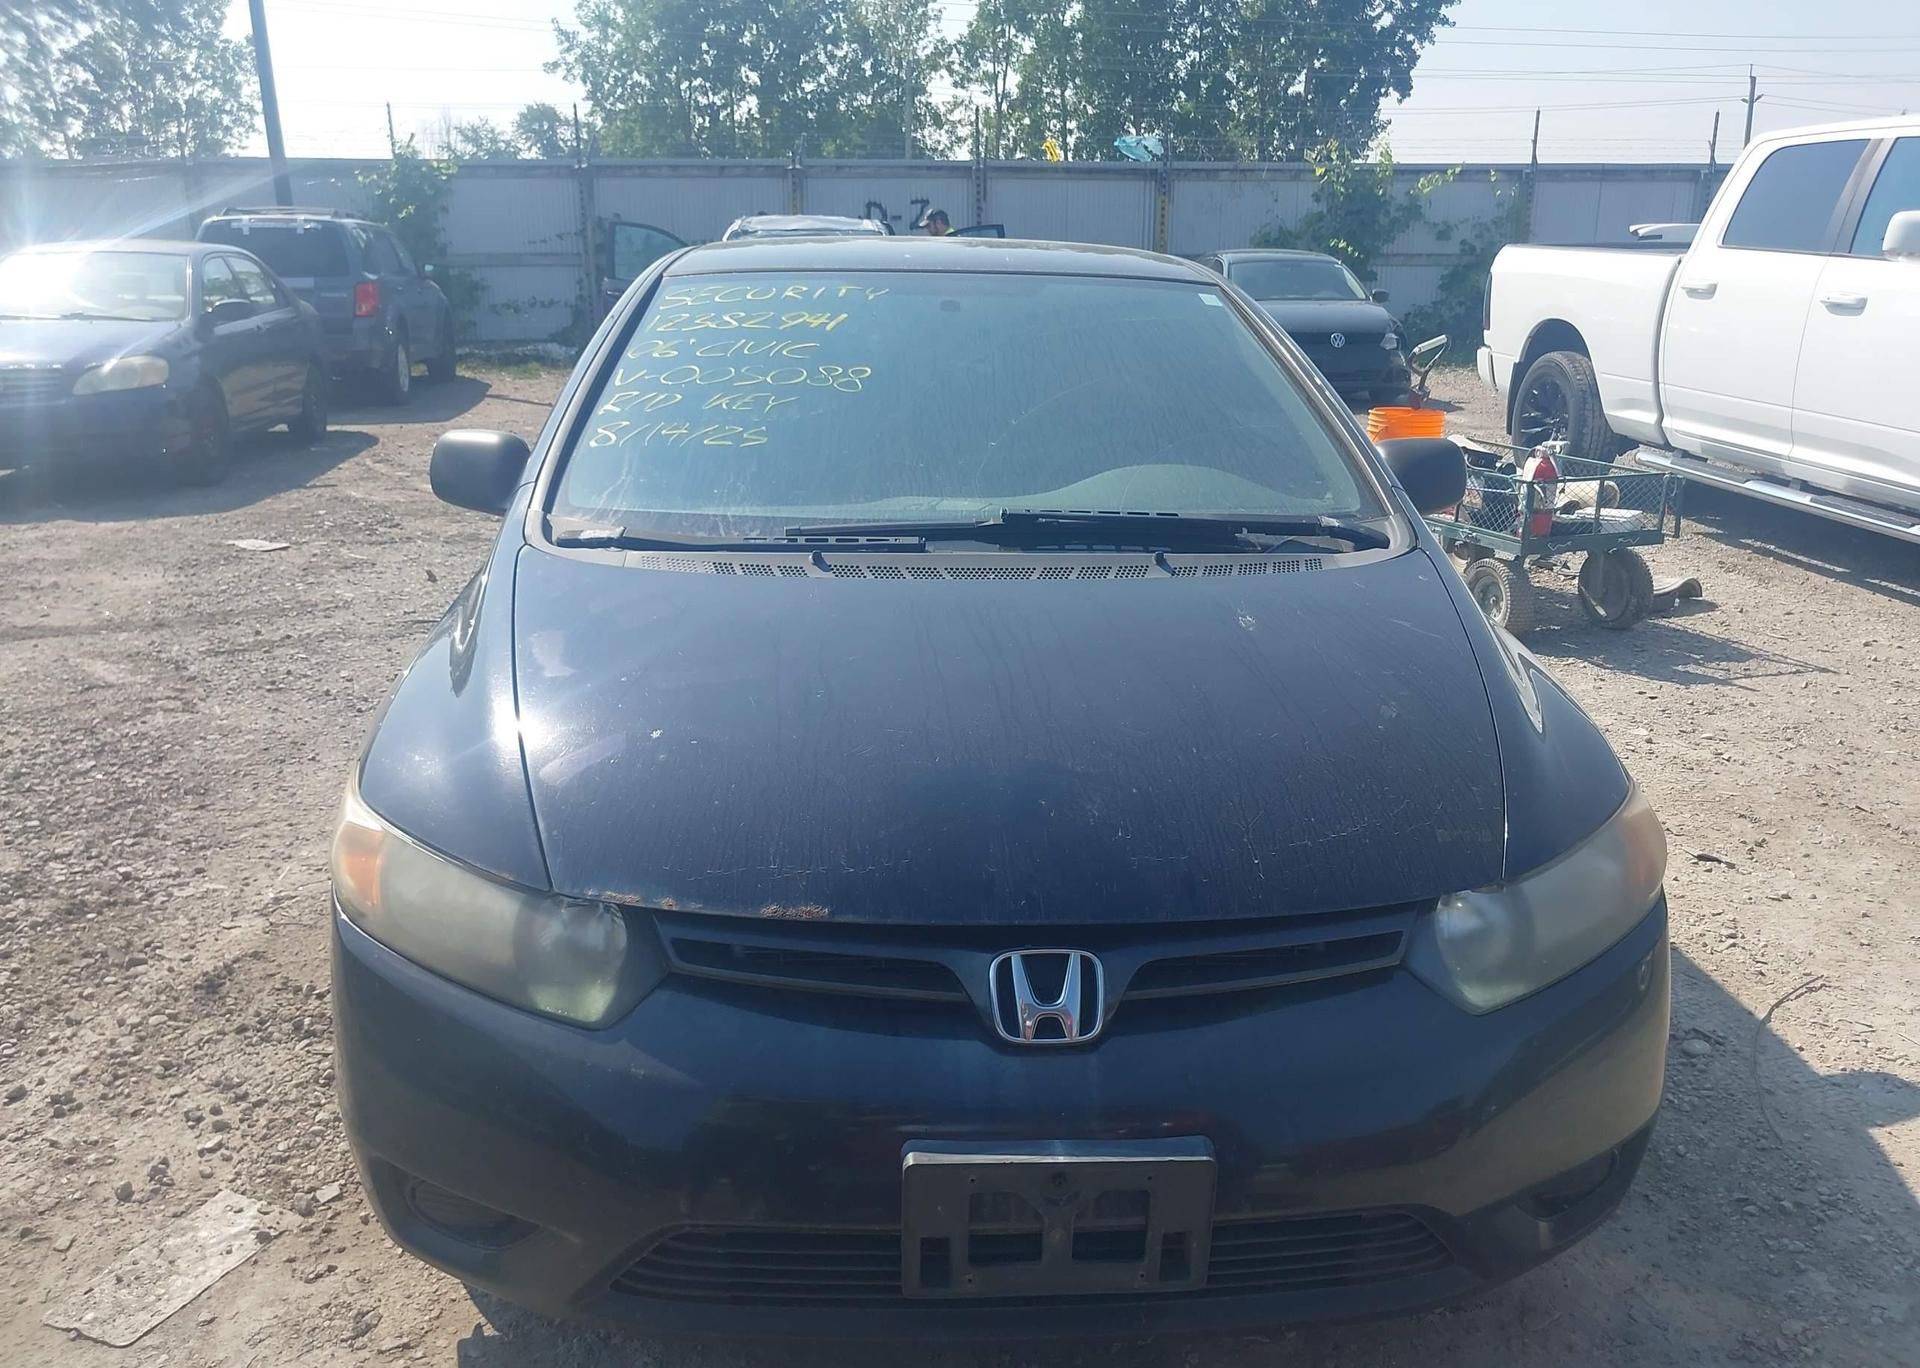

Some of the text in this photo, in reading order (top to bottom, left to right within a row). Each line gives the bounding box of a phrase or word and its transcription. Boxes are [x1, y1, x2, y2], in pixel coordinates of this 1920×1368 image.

[660, 285, 889, 310] SECURITY
[646, 311, 849, 332] 12382941
[702, 392, 800, 414] KEY
[588, 421, 769, 448] 8/14/25
